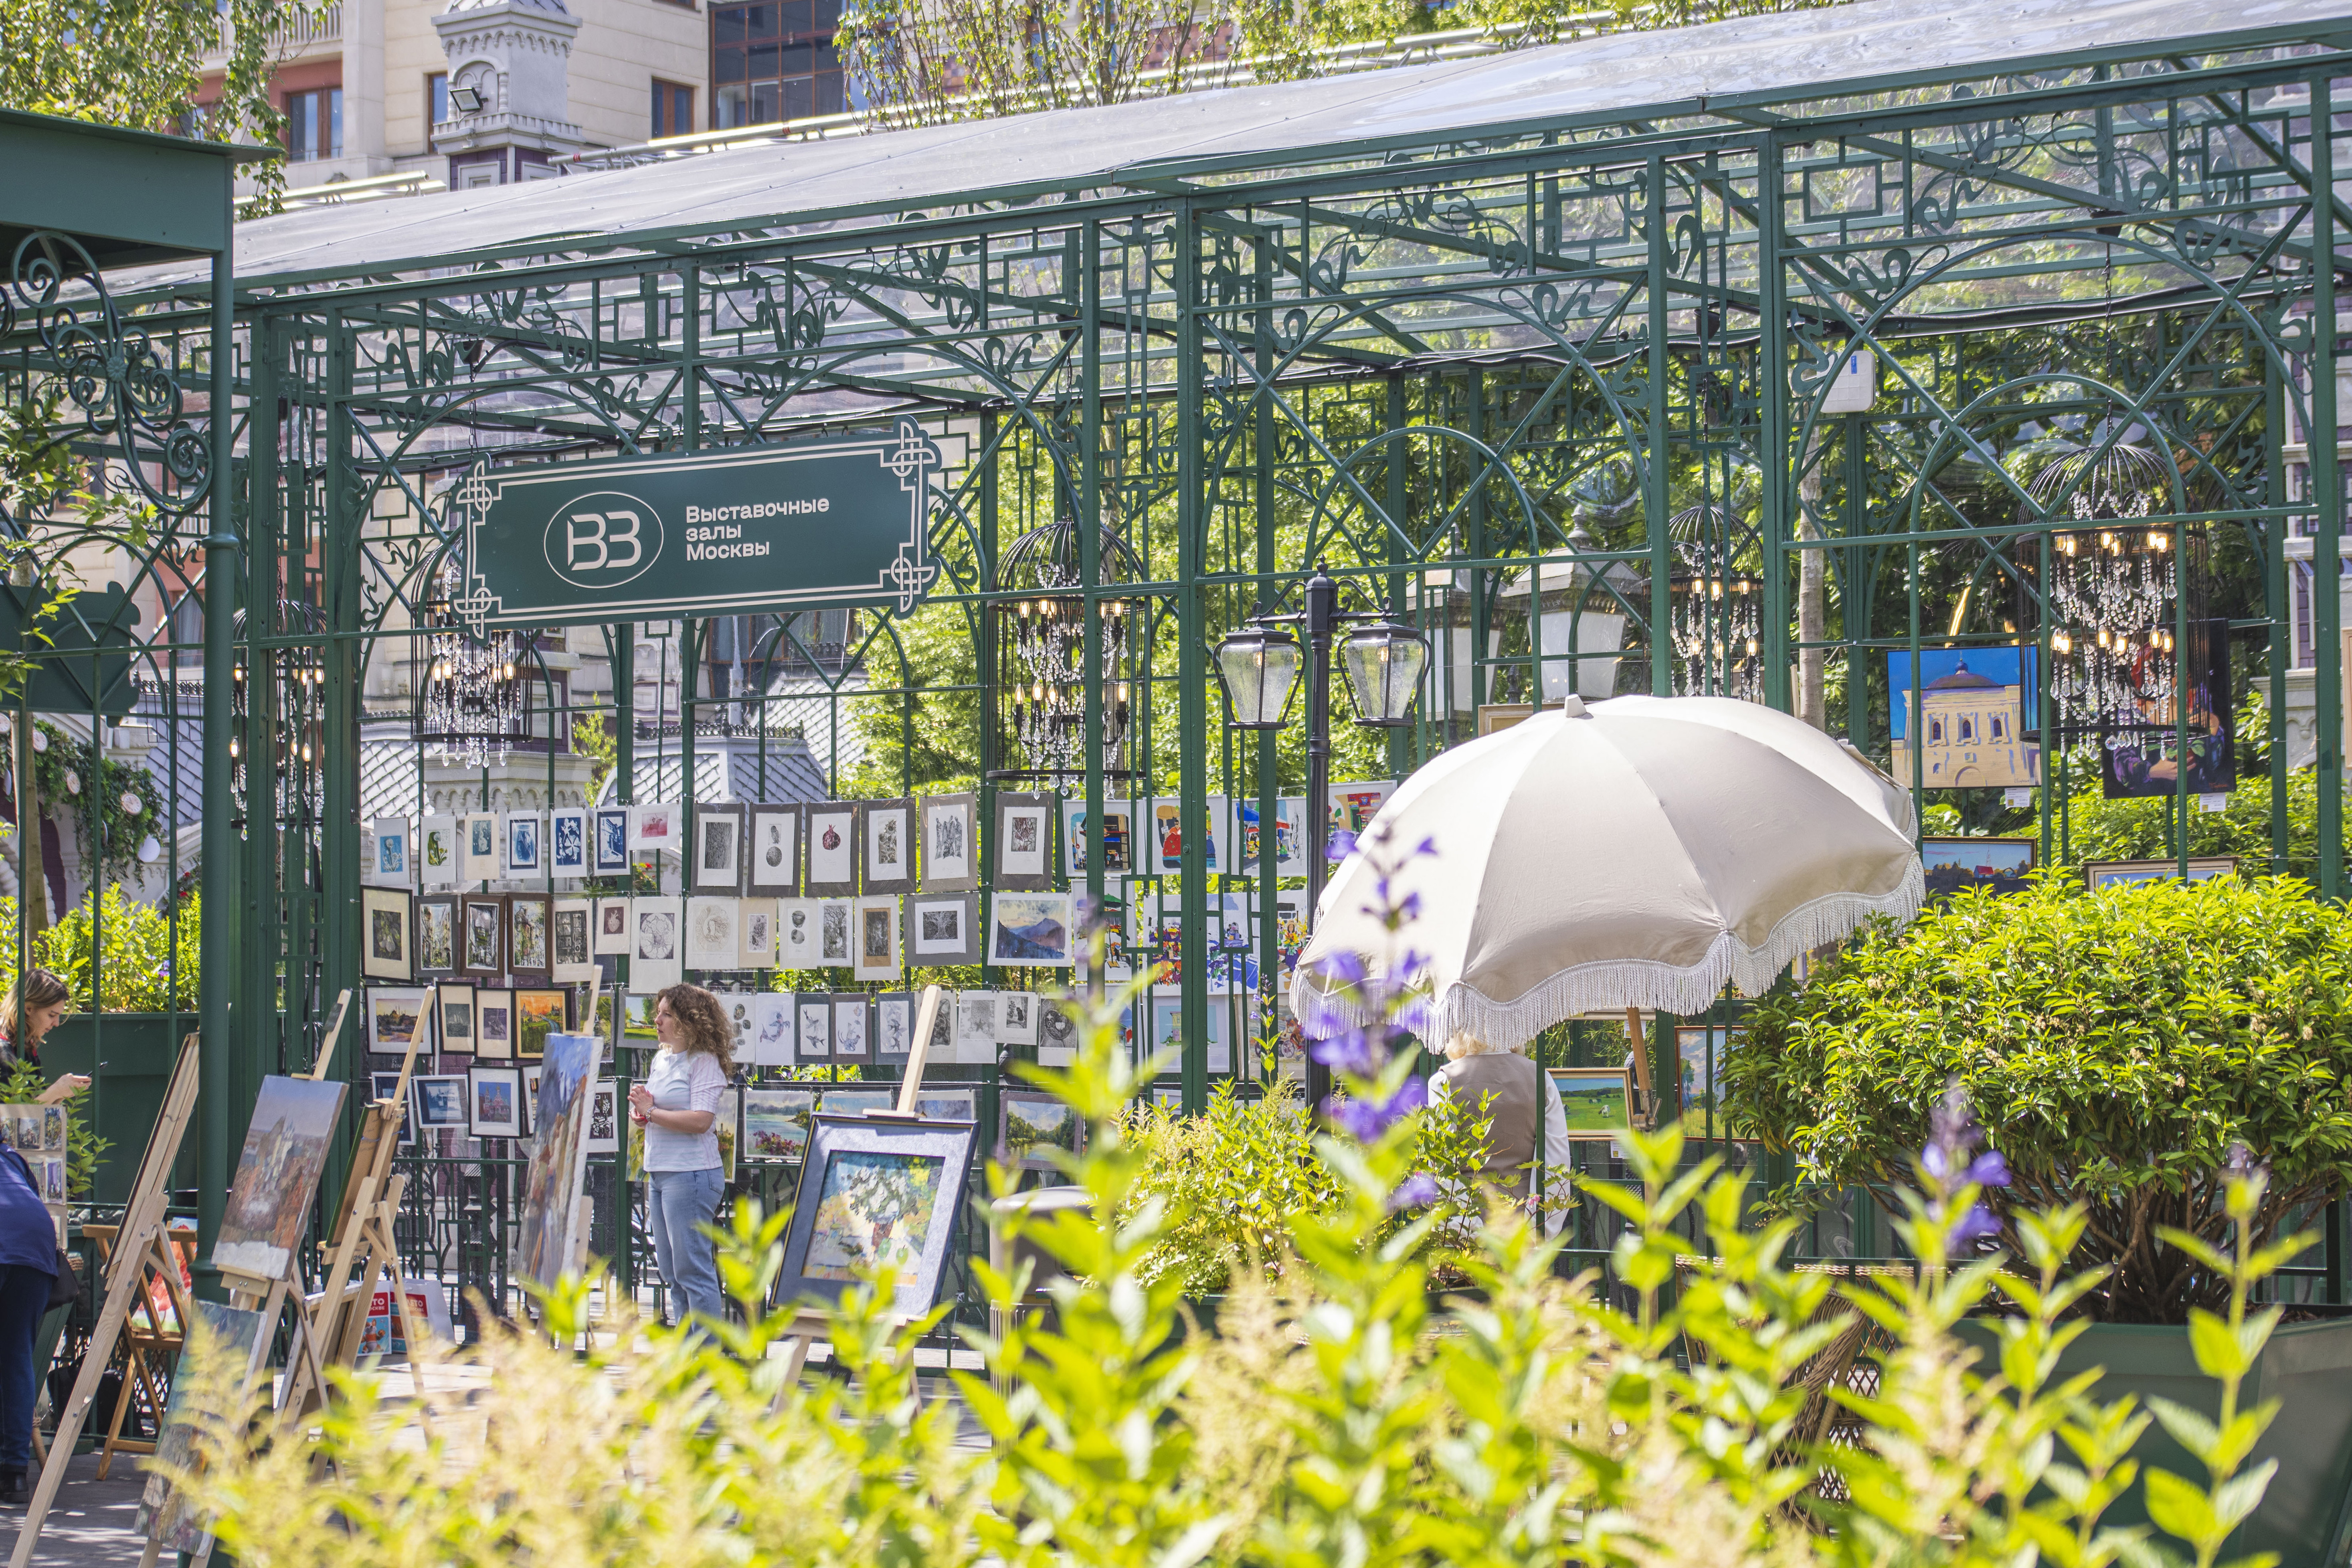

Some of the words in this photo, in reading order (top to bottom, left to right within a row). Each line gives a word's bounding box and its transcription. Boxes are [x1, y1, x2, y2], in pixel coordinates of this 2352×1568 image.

[686, 498, 830, 523] Выставочные
[686, 524, 742, 542] залы
[686, 542, 769, 561] Москвы
